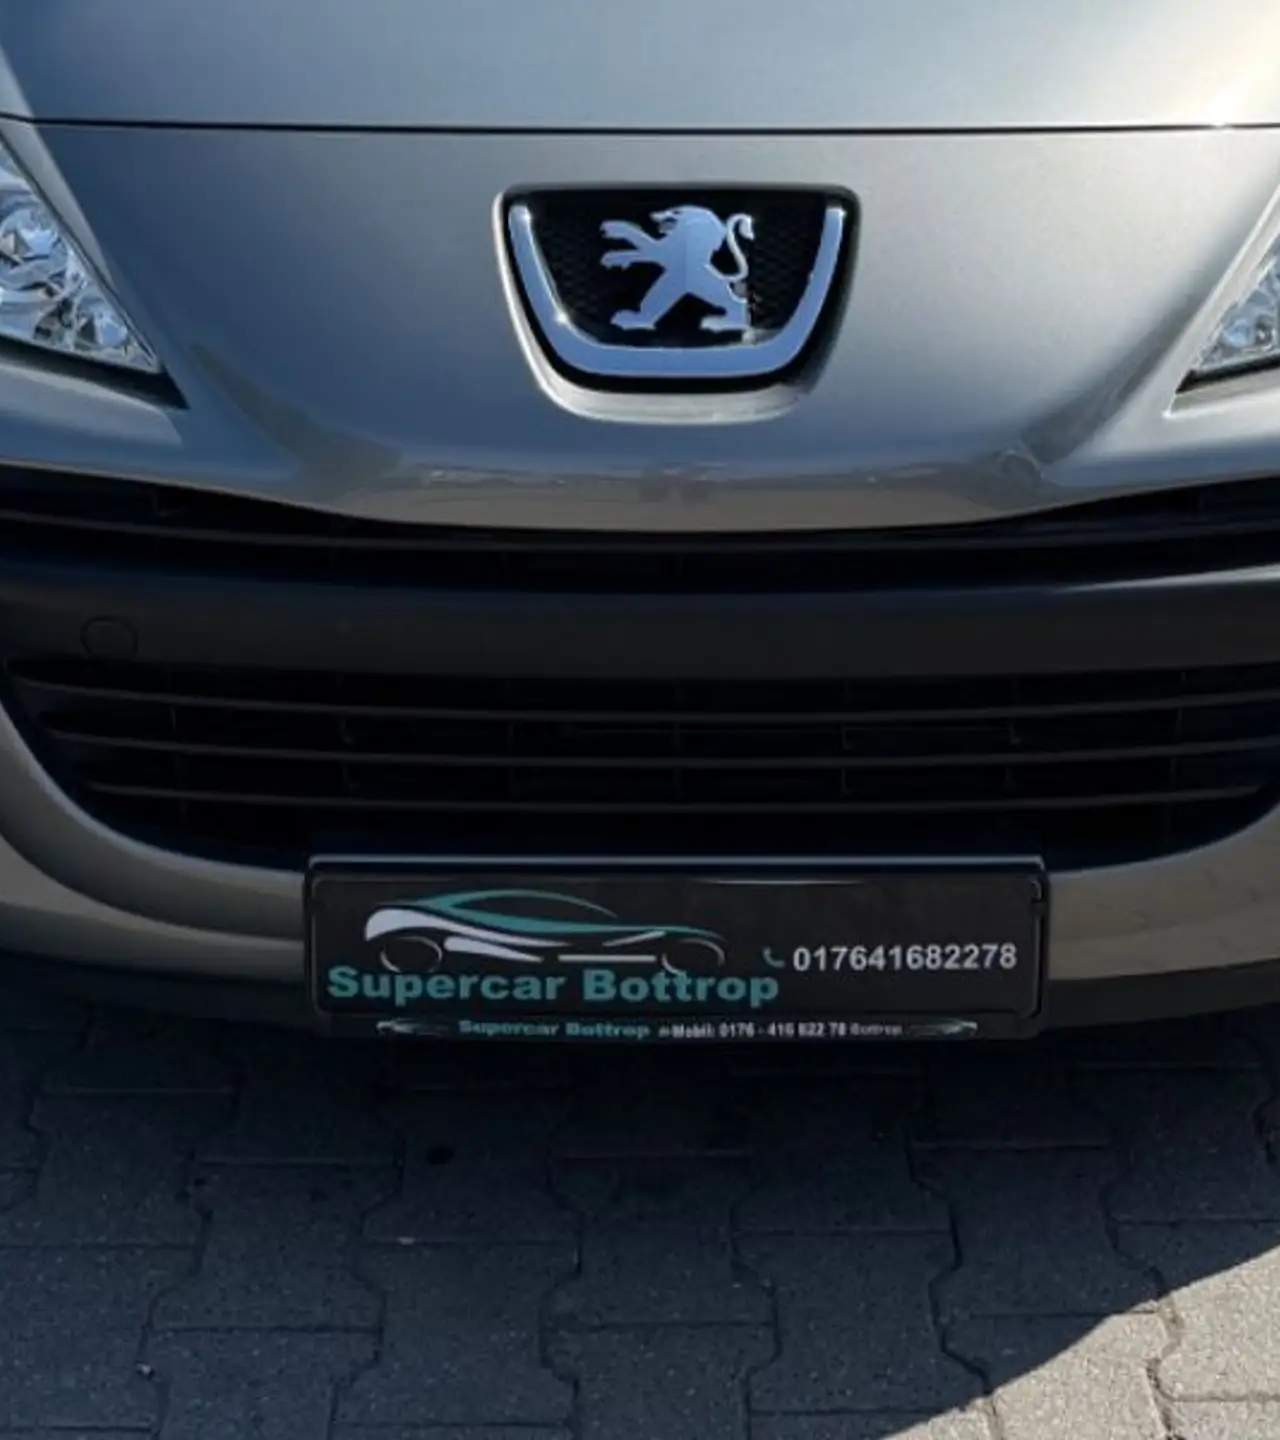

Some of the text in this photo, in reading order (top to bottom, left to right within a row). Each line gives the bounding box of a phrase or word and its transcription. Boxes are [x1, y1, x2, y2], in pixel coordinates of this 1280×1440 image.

[793, 942, 1018, 973] 017641682278
[327, 964, 779, 1008] Supercar Bottrop
[458, 1019, 560, 1038] Supercar
[566, 1021, 651, 1040] Bottrop
[719, 1021, 755, 1039] 0176
